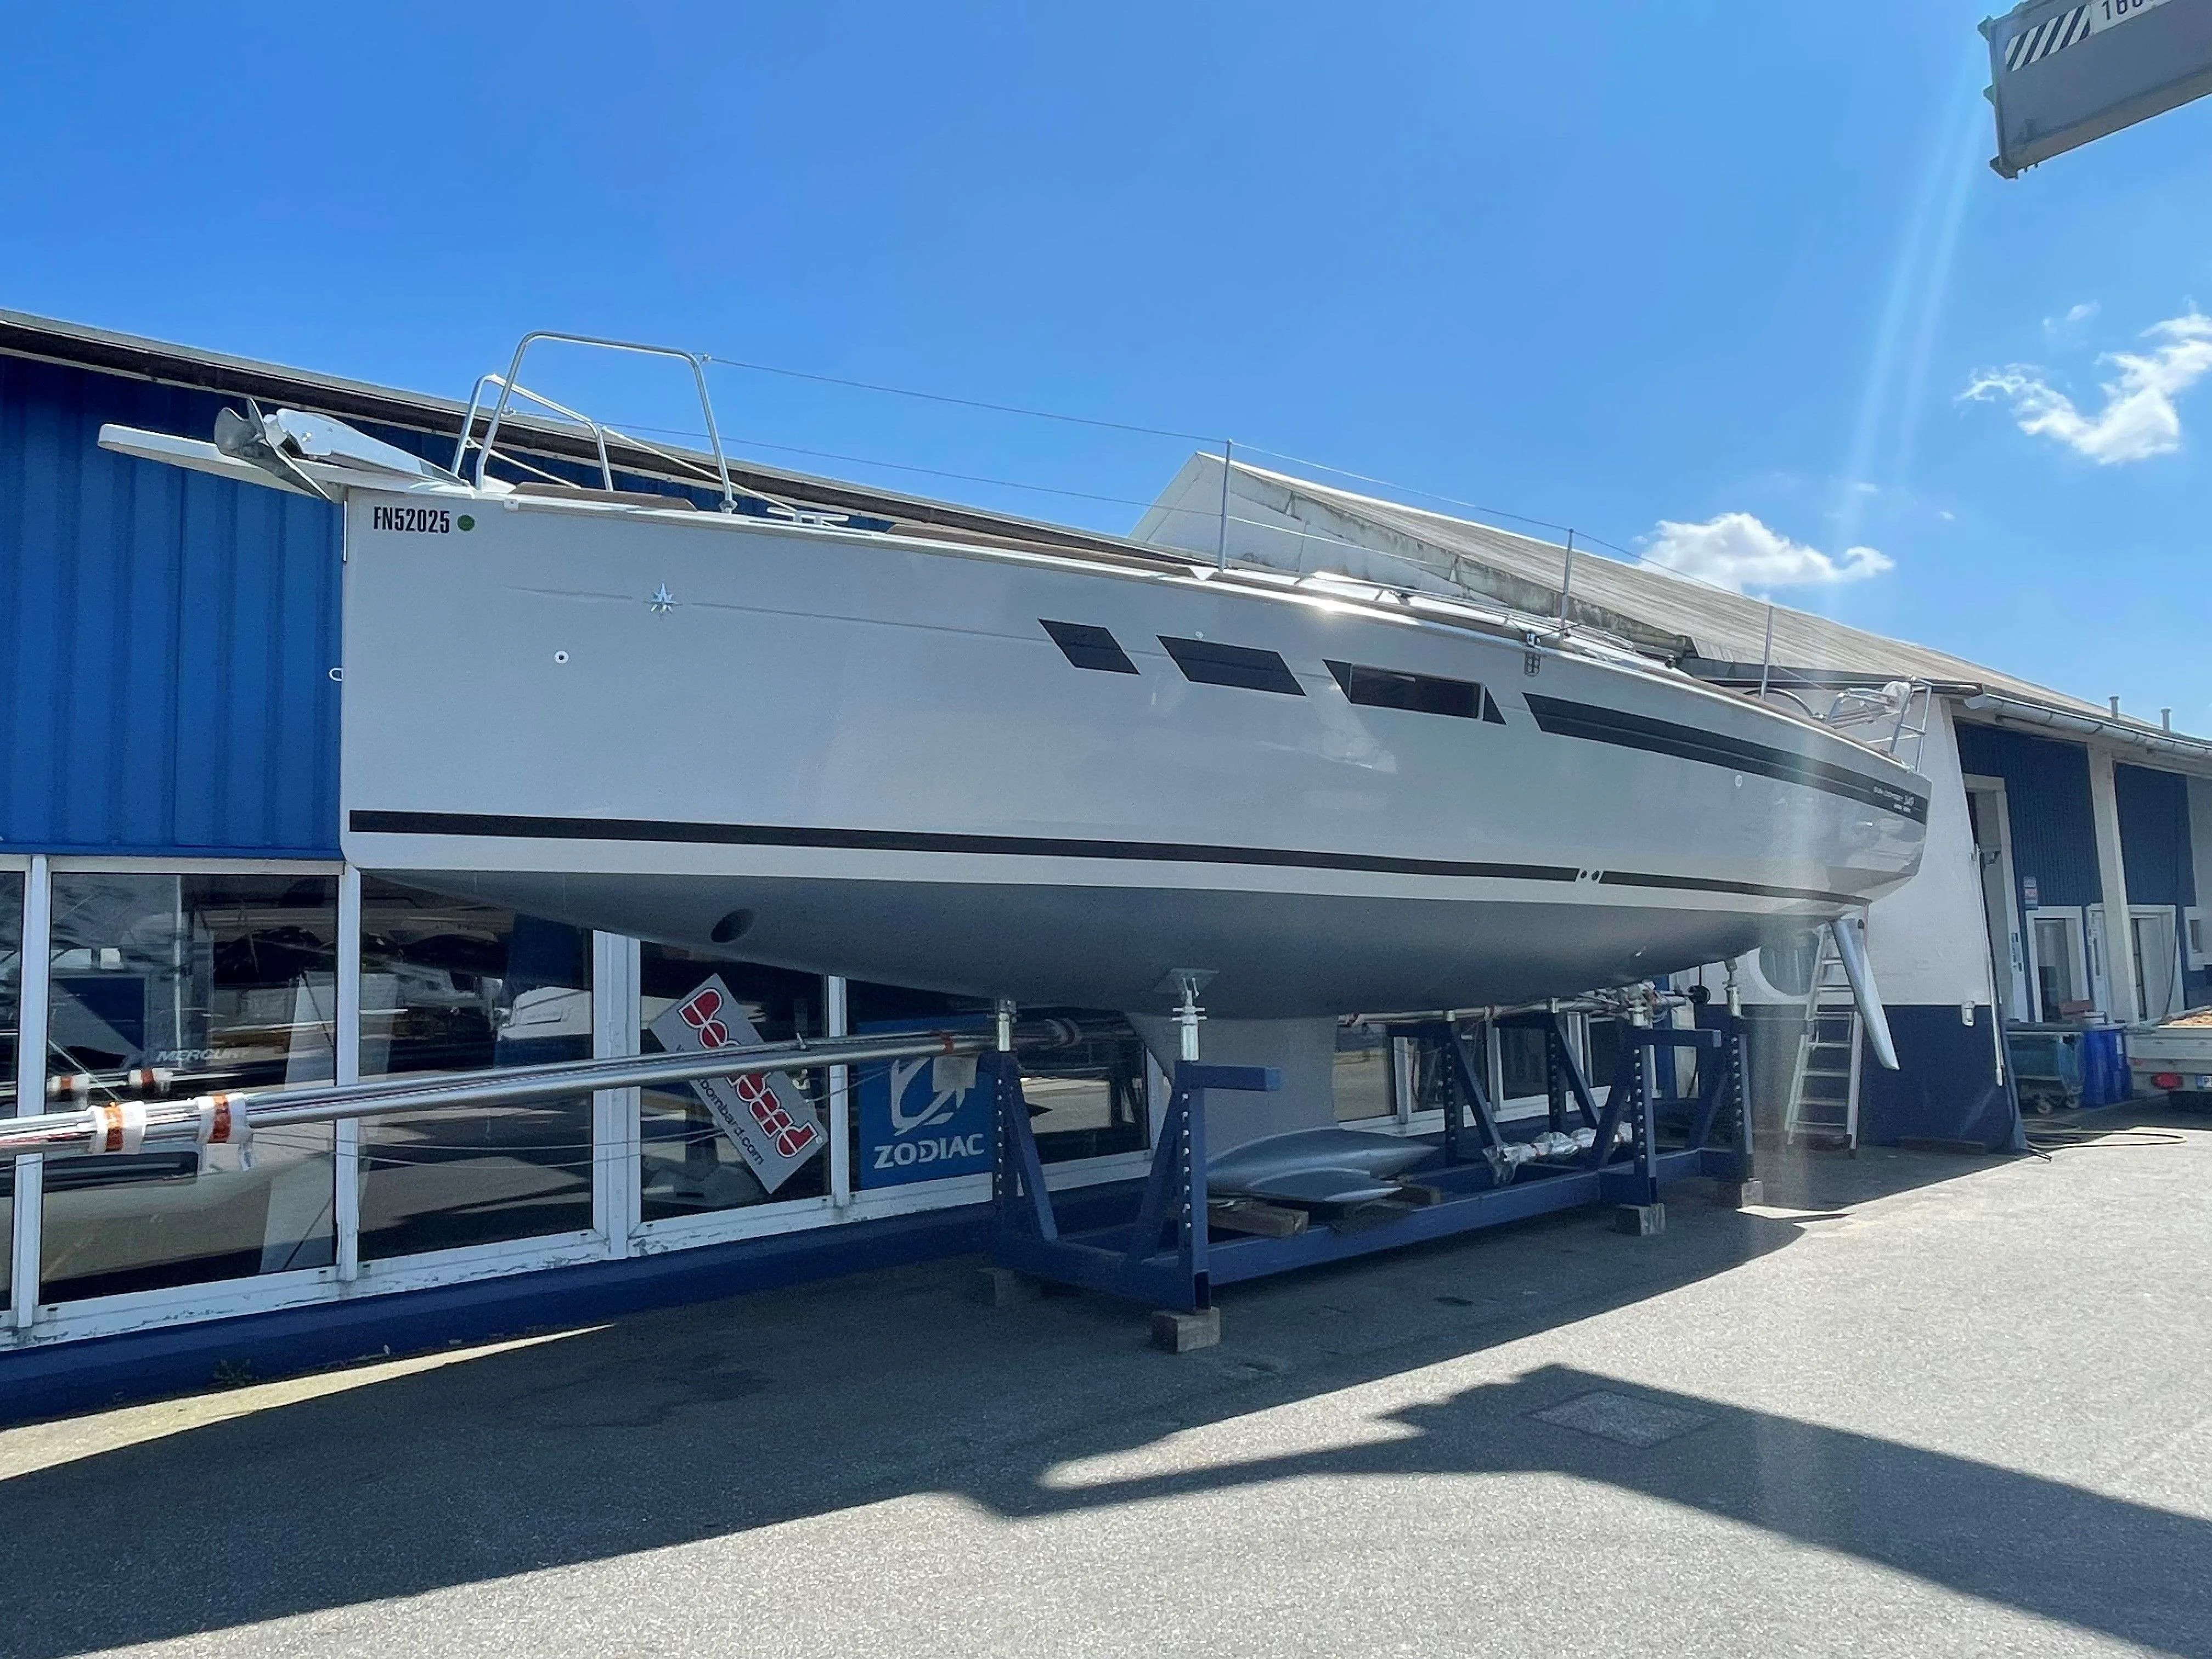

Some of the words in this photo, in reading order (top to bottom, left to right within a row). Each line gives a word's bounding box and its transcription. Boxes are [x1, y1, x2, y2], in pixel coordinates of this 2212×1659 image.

[373, 506, 450, 533] FN52025
[155, 1048, 250, 1062] MERCUR
[678, 988, 819, 1158] Bobard
[873, 1133, 985, 1169] ZODIAC
